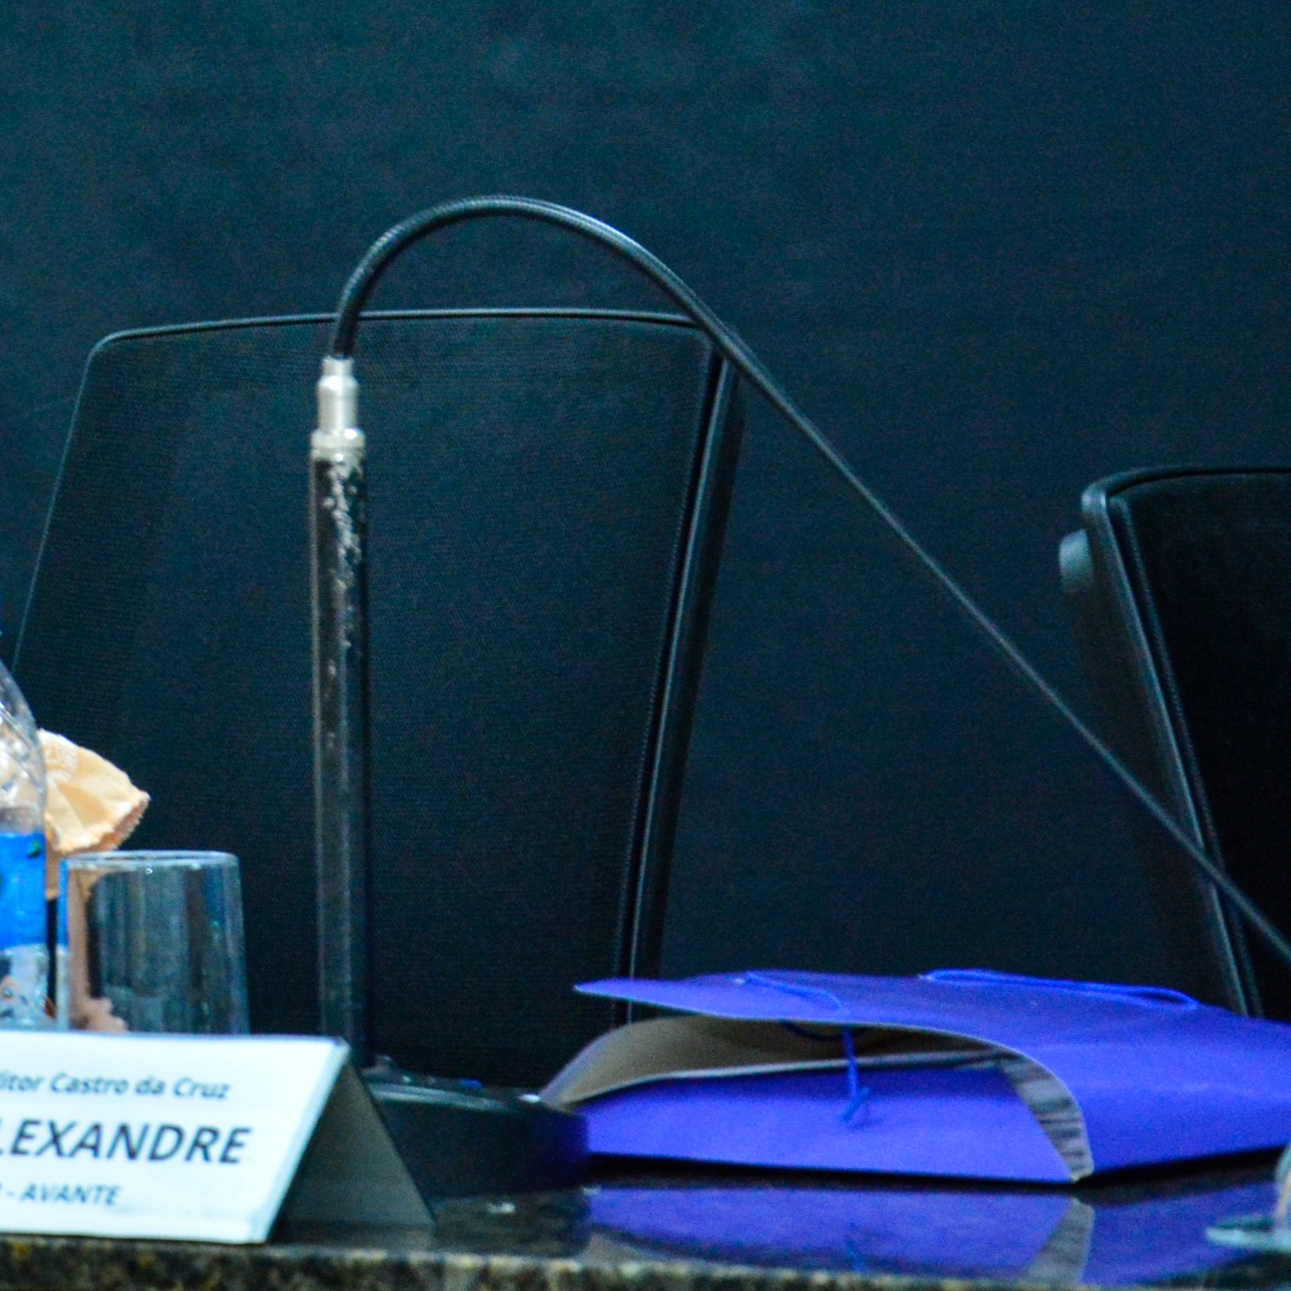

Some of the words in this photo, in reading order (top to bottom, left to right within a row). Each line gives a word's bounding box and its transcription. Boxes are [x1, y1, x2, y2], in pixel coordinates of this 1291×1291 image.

[50, 1072, 129, 1095] Castro
[134, 1075, 166, 1096] da
[173, 1077, 231, 1099] Cruz
[20, 1182, 122, 1205] AVANTE
